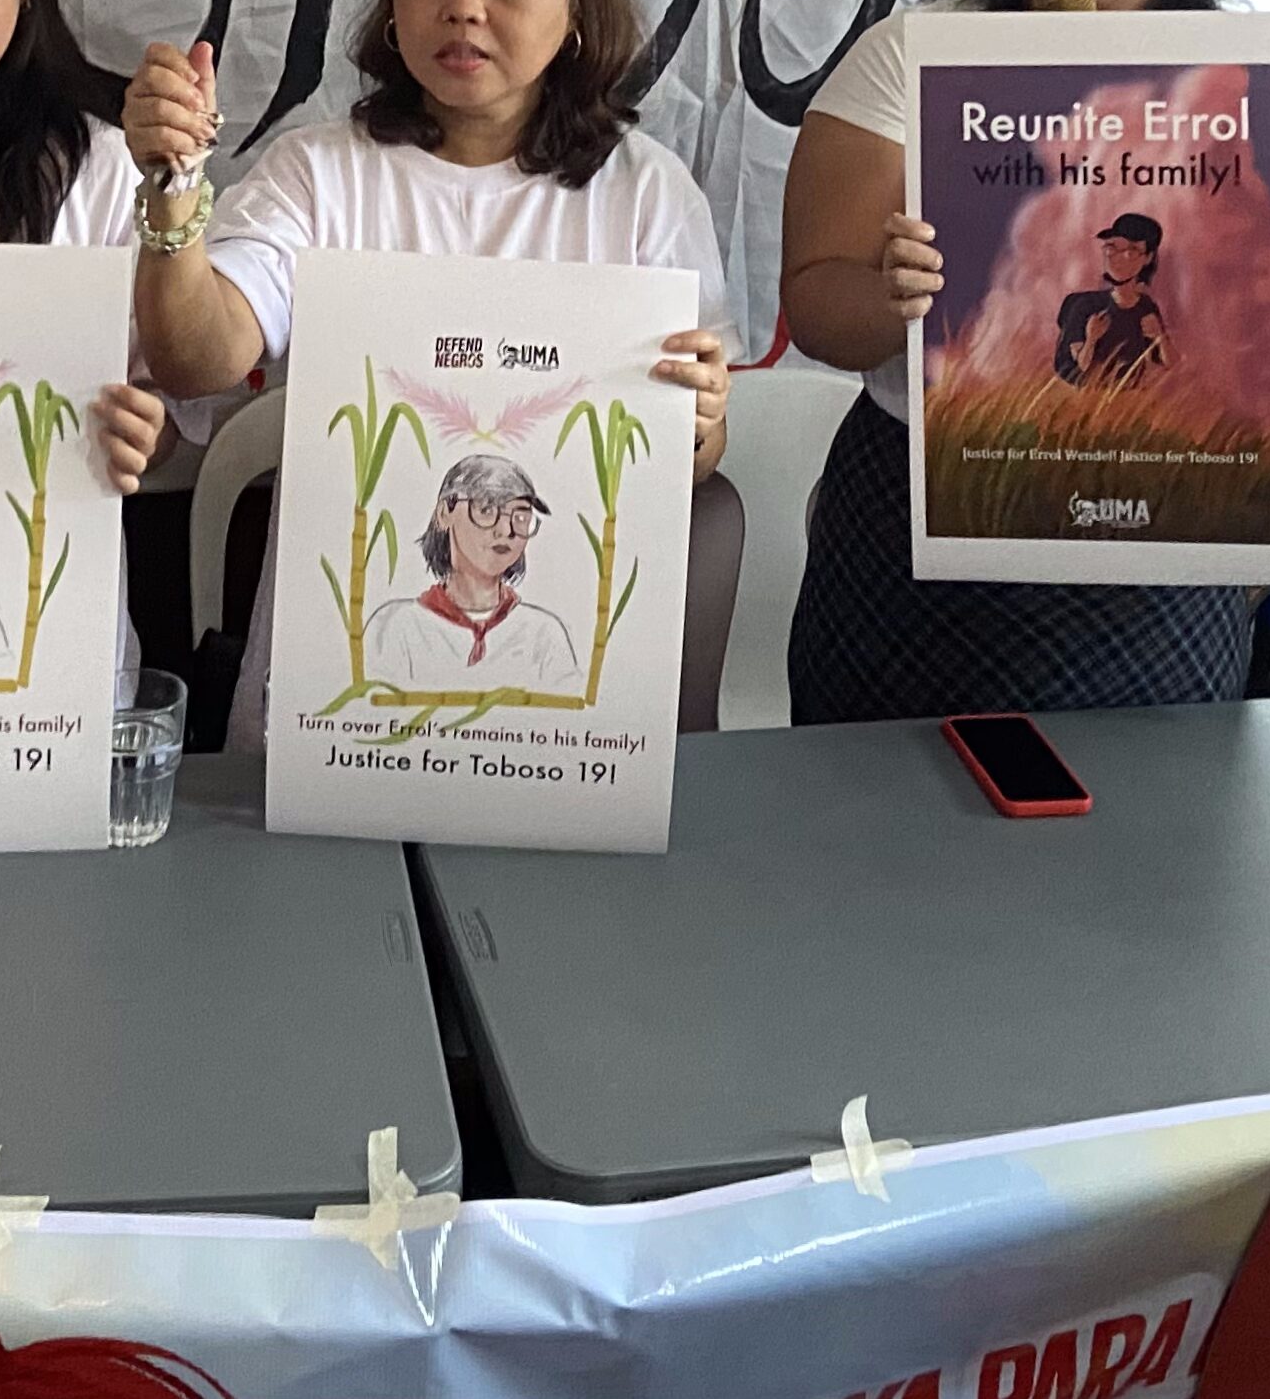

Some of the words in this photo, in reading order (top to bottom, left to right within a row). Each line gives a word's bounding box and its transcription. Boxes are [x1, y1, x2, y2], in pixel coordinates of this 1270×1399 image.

[962, 101, 1125, 142] Reunite
[1143, 96, 1249, 142] Errol
[973, 152, 1046, 187] with
[1059, 152, 1107, 186] his
[1120, 151, 1242, 196] family!
[435, 337, 483, 352] DEFEND
[521, 344, 560, 367] UMA
[434, 352, 484, 368] NEGROS
[962, 447, 1005, 461] Justice
[1007, 447, 1027, 461] for
[1029, 448, 1062, 461] Errol
[1165, 450, 1185, 464] for
[1187, 450, 1235, 464] Toboso
[1239, 451, 1259, 465] 19!
[1098, 499, 1151, 523] UMA
[18, 714, 82, 739] family!
[296, 713, 335, 732] Turn
[342, 720, 383, 735] over
[389, 720, 447, 739] Errol's
[453, 725, 524, 744] remains
[530, 728, 548, 745] to
[554, 728, 578, 747] his
[583, 730, 647, 755] family!
[13, 746, 52, 772] 19!
[325, 744, 412, 772] Justice
[422, 749, 460, 774] for
[469, 753, 565, 782] Toboso
[577, 761, 618, 786] 19!
